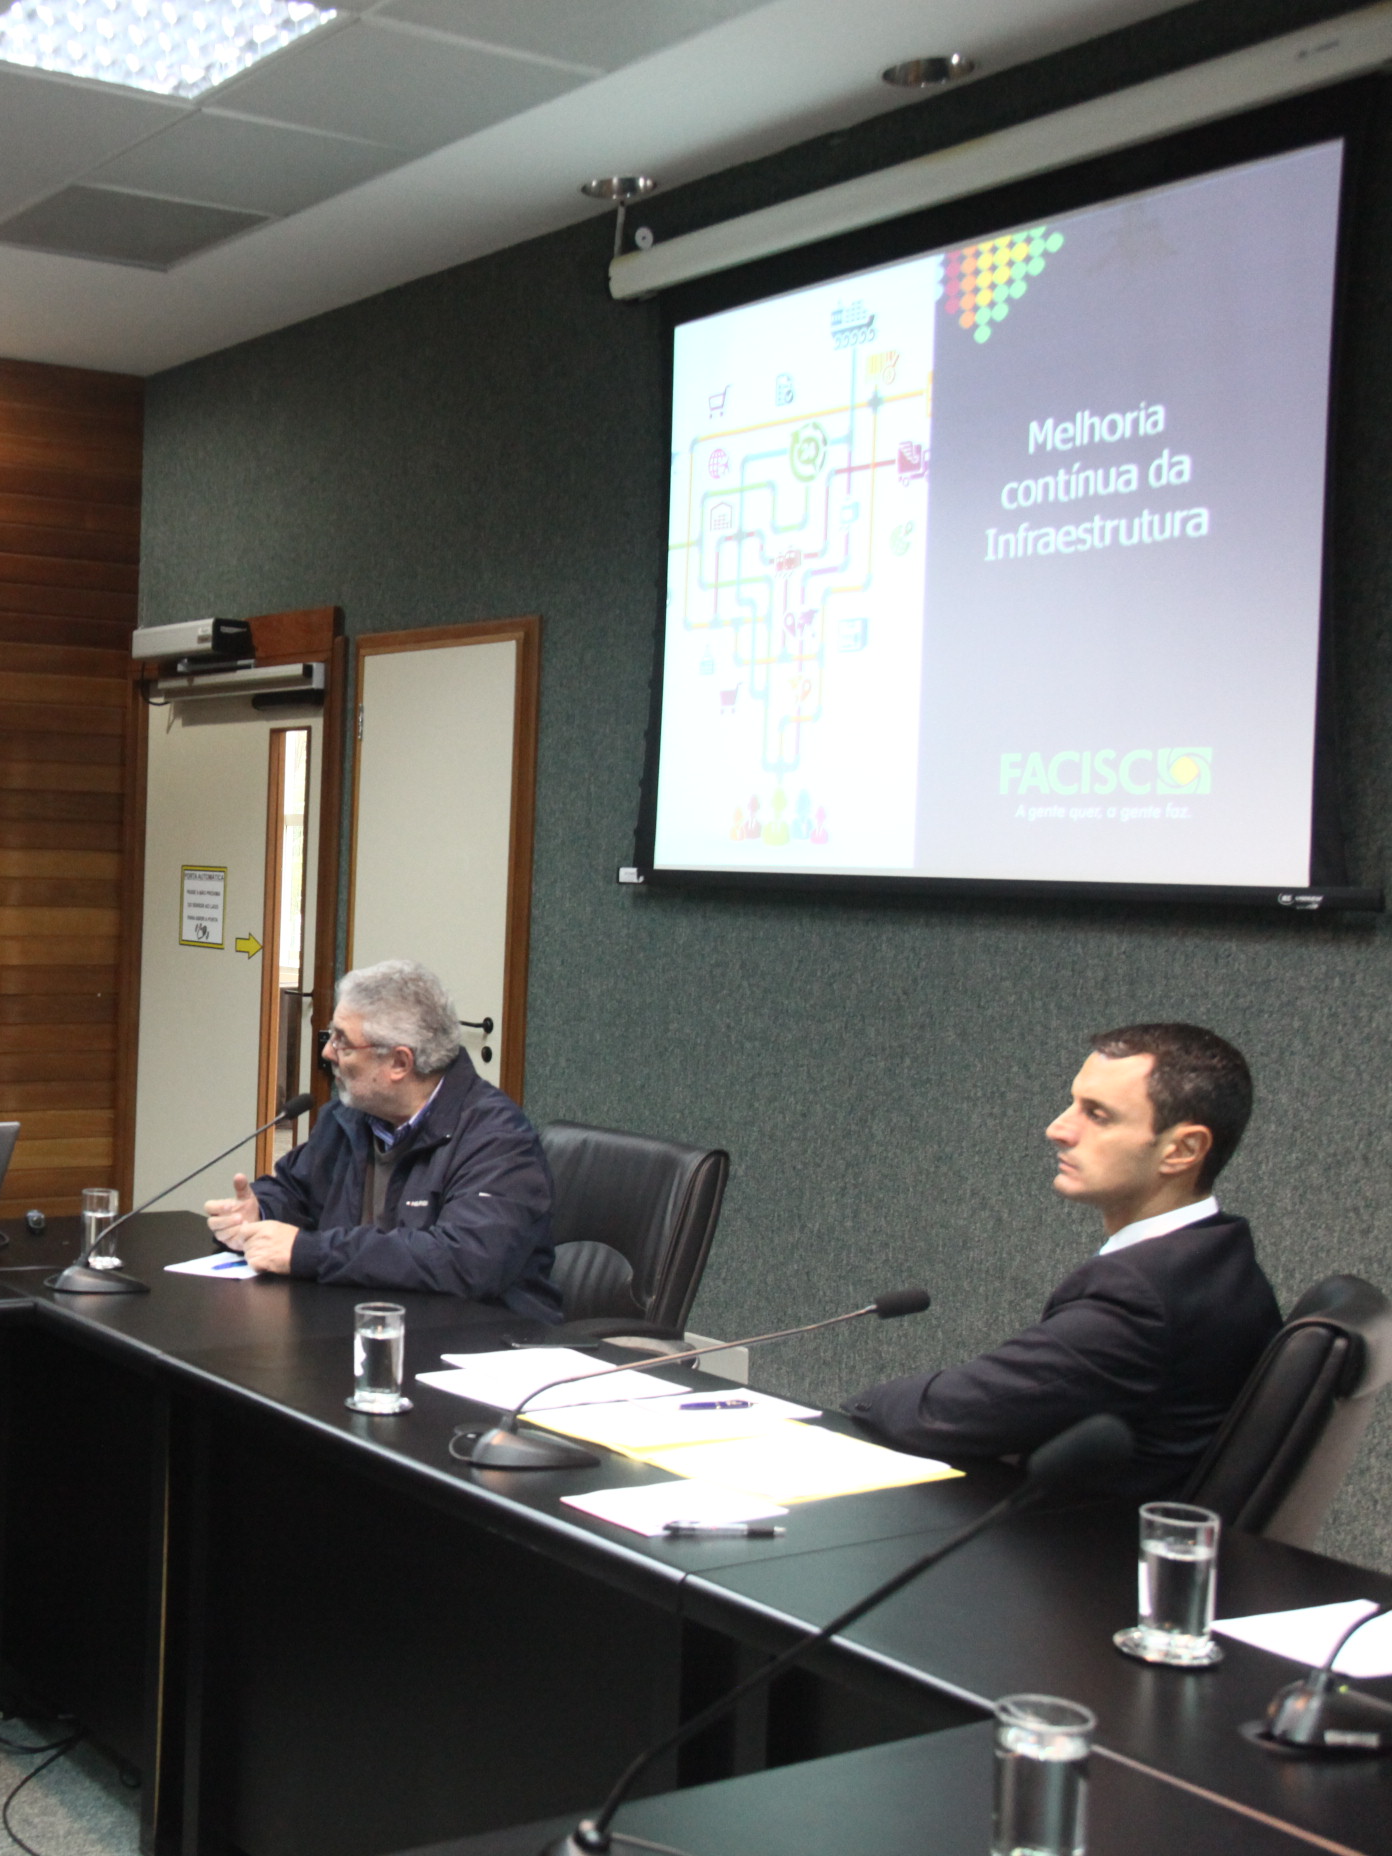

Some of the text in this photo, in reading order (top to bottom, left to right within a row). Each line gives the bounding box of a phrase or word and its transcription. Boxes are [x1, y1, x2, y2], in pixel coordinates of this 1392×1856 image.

[1028, 401, 1165, 455] Melhoria
[1001, 448, 1192, 510] contínua da
[984, 507, 1210, 561] Infraestrutura
[999, 748, 1153, 796] FACISC
[1015, 804, 1027, 818] A
[1028, 805, 1065, 821] gente
[1107, 807, 1116, 818] a
[1120, 805, 1160, 822] gente
